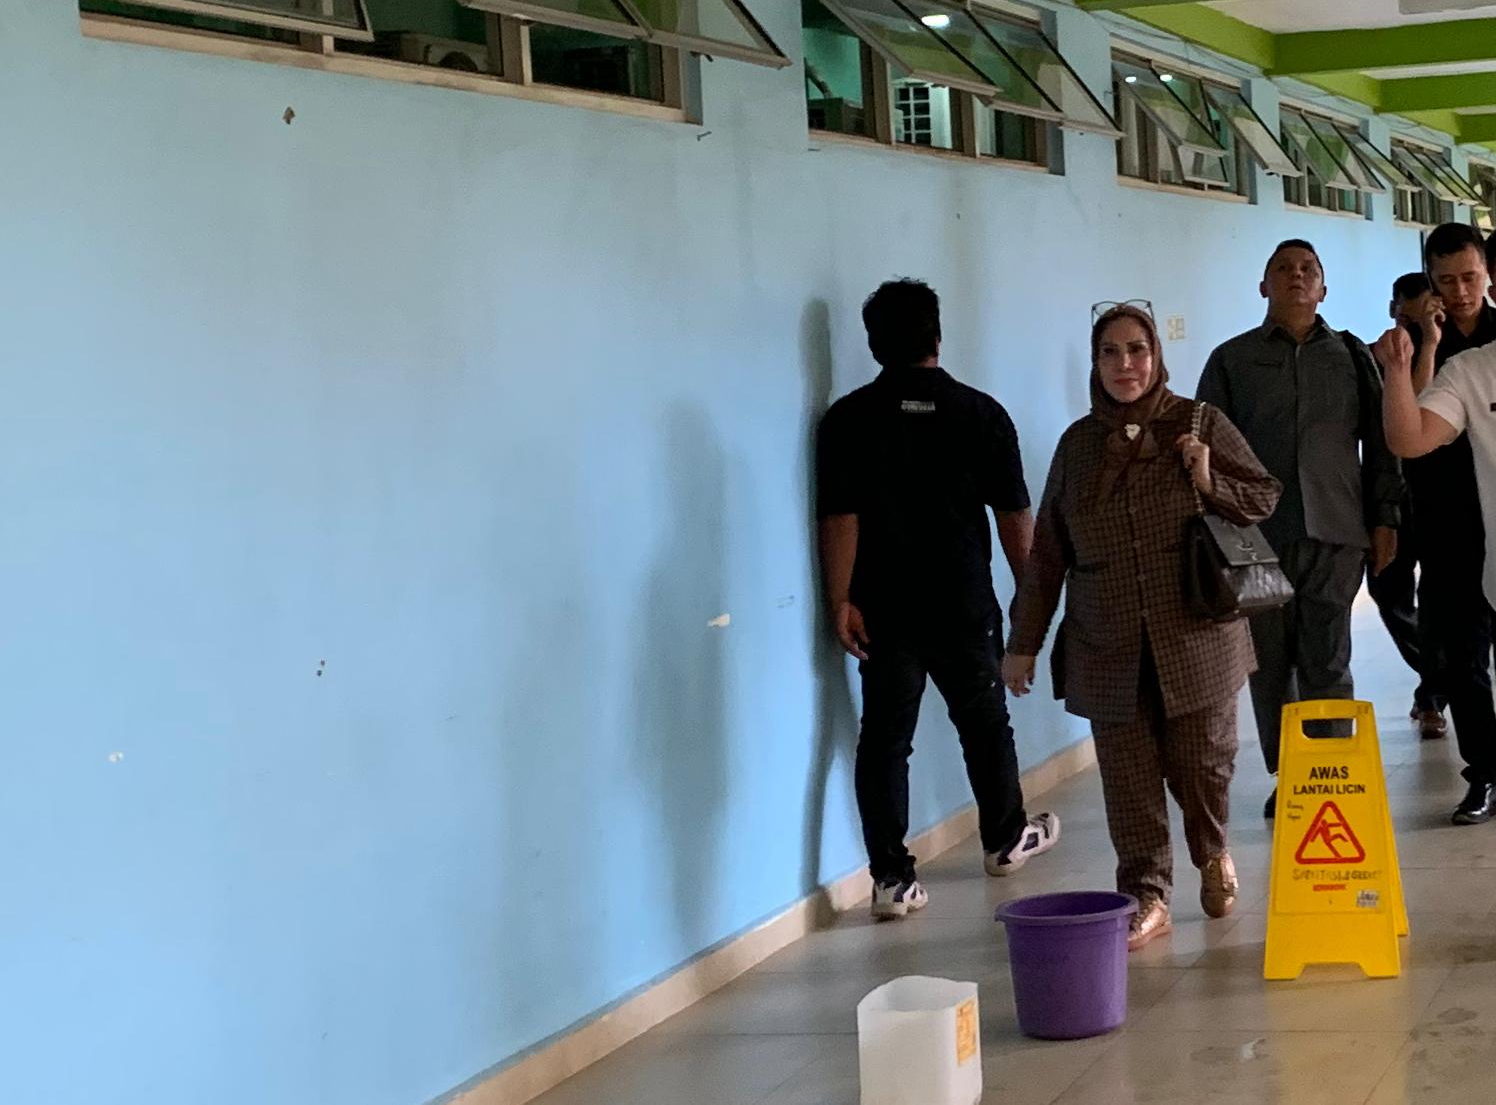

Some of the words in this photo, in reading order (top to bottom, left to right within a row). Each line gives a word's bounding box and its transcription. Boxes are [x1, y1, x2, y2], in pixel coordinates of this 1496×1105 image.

[1308, 765, 1350, 780] AWAS
[1292, 784, 1335, 795] LANTAI
[1335, 783, 1366, 795] LICIN
